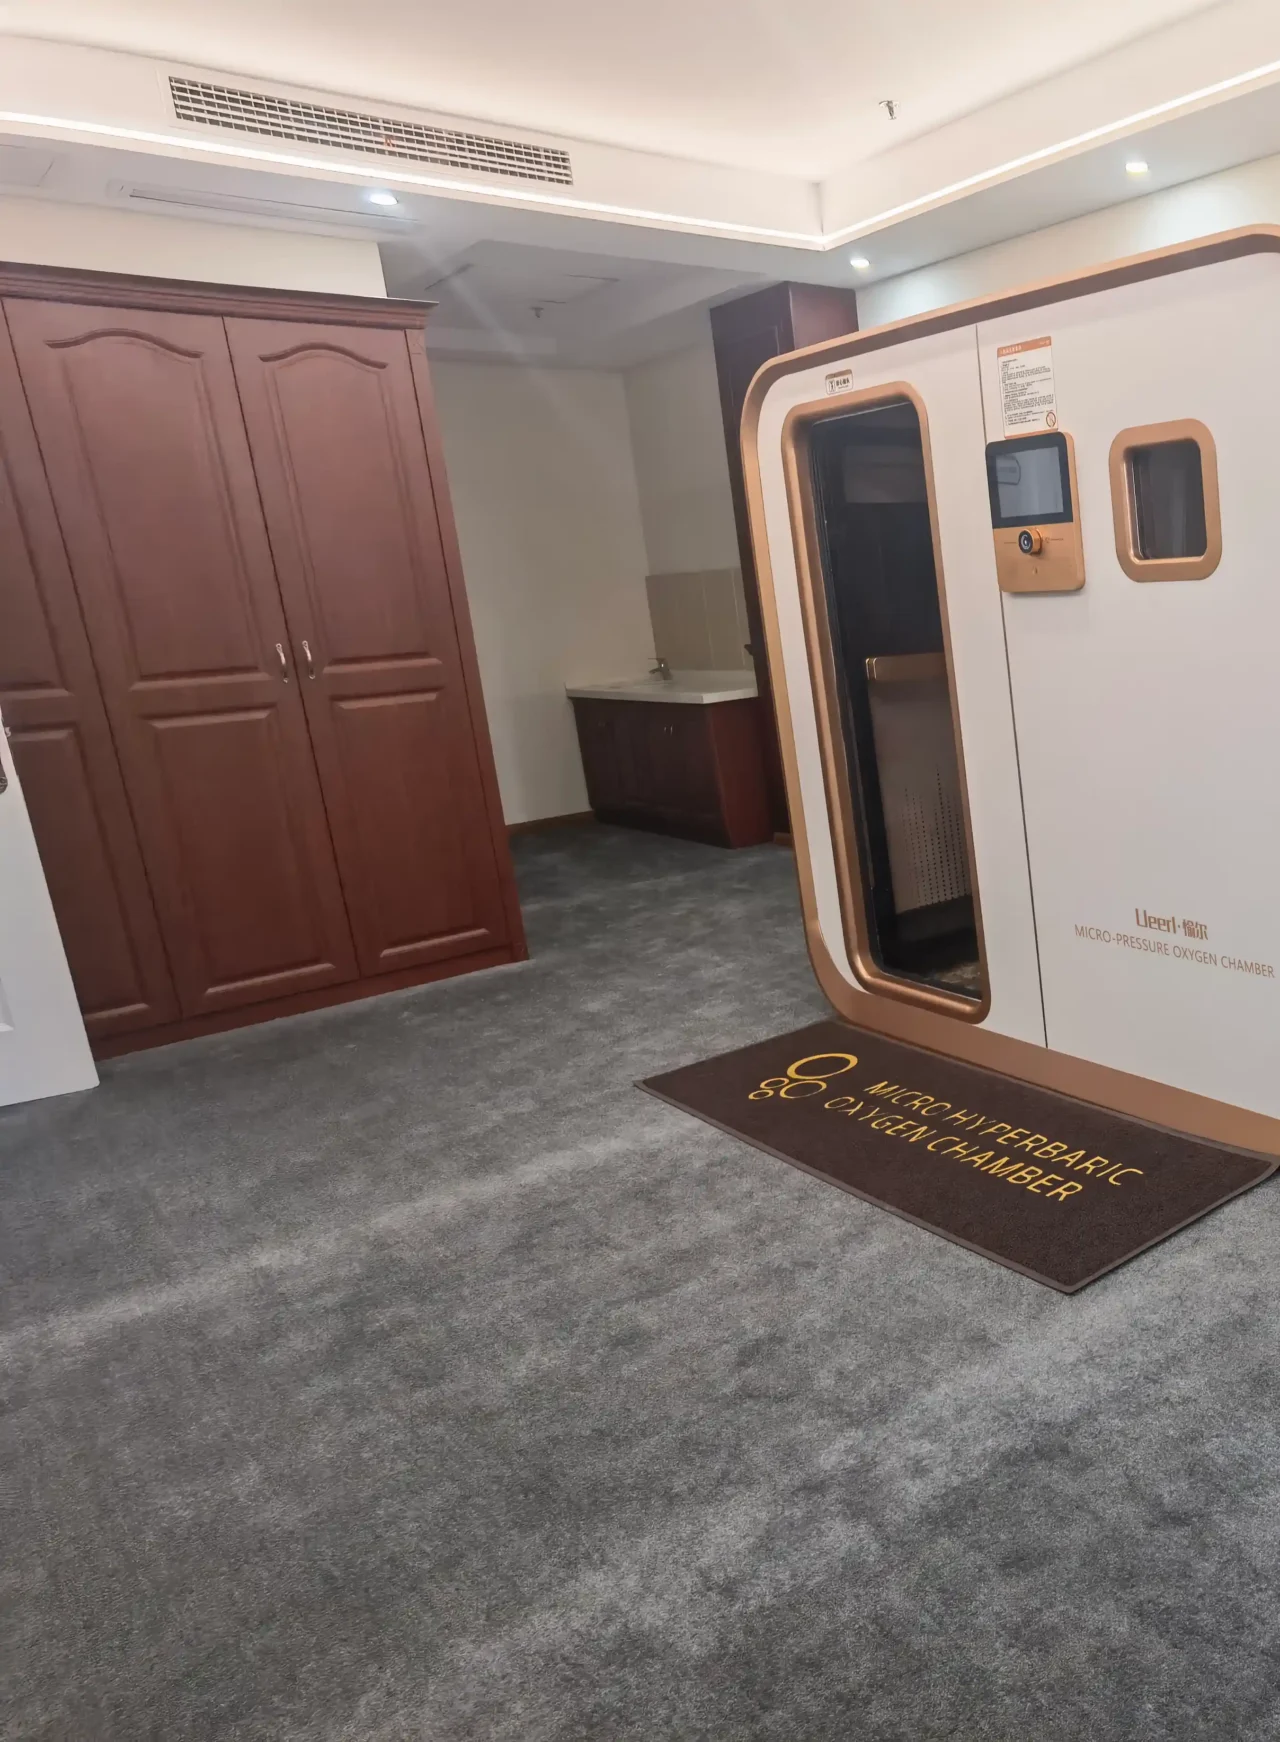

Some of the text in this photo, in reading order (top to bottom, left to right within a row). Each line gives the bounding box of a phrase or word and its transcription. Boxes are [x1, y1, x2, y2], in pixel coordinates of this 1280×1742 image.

[1074, 924, 1275, 978] MICRO-PRESSURE OXYGEN CHAMBER
[824, 1096, 1084, 1202] OXYGEN CHAMBER
[863, 1080, 1143, 1186] MICRO HYPERBARIC
